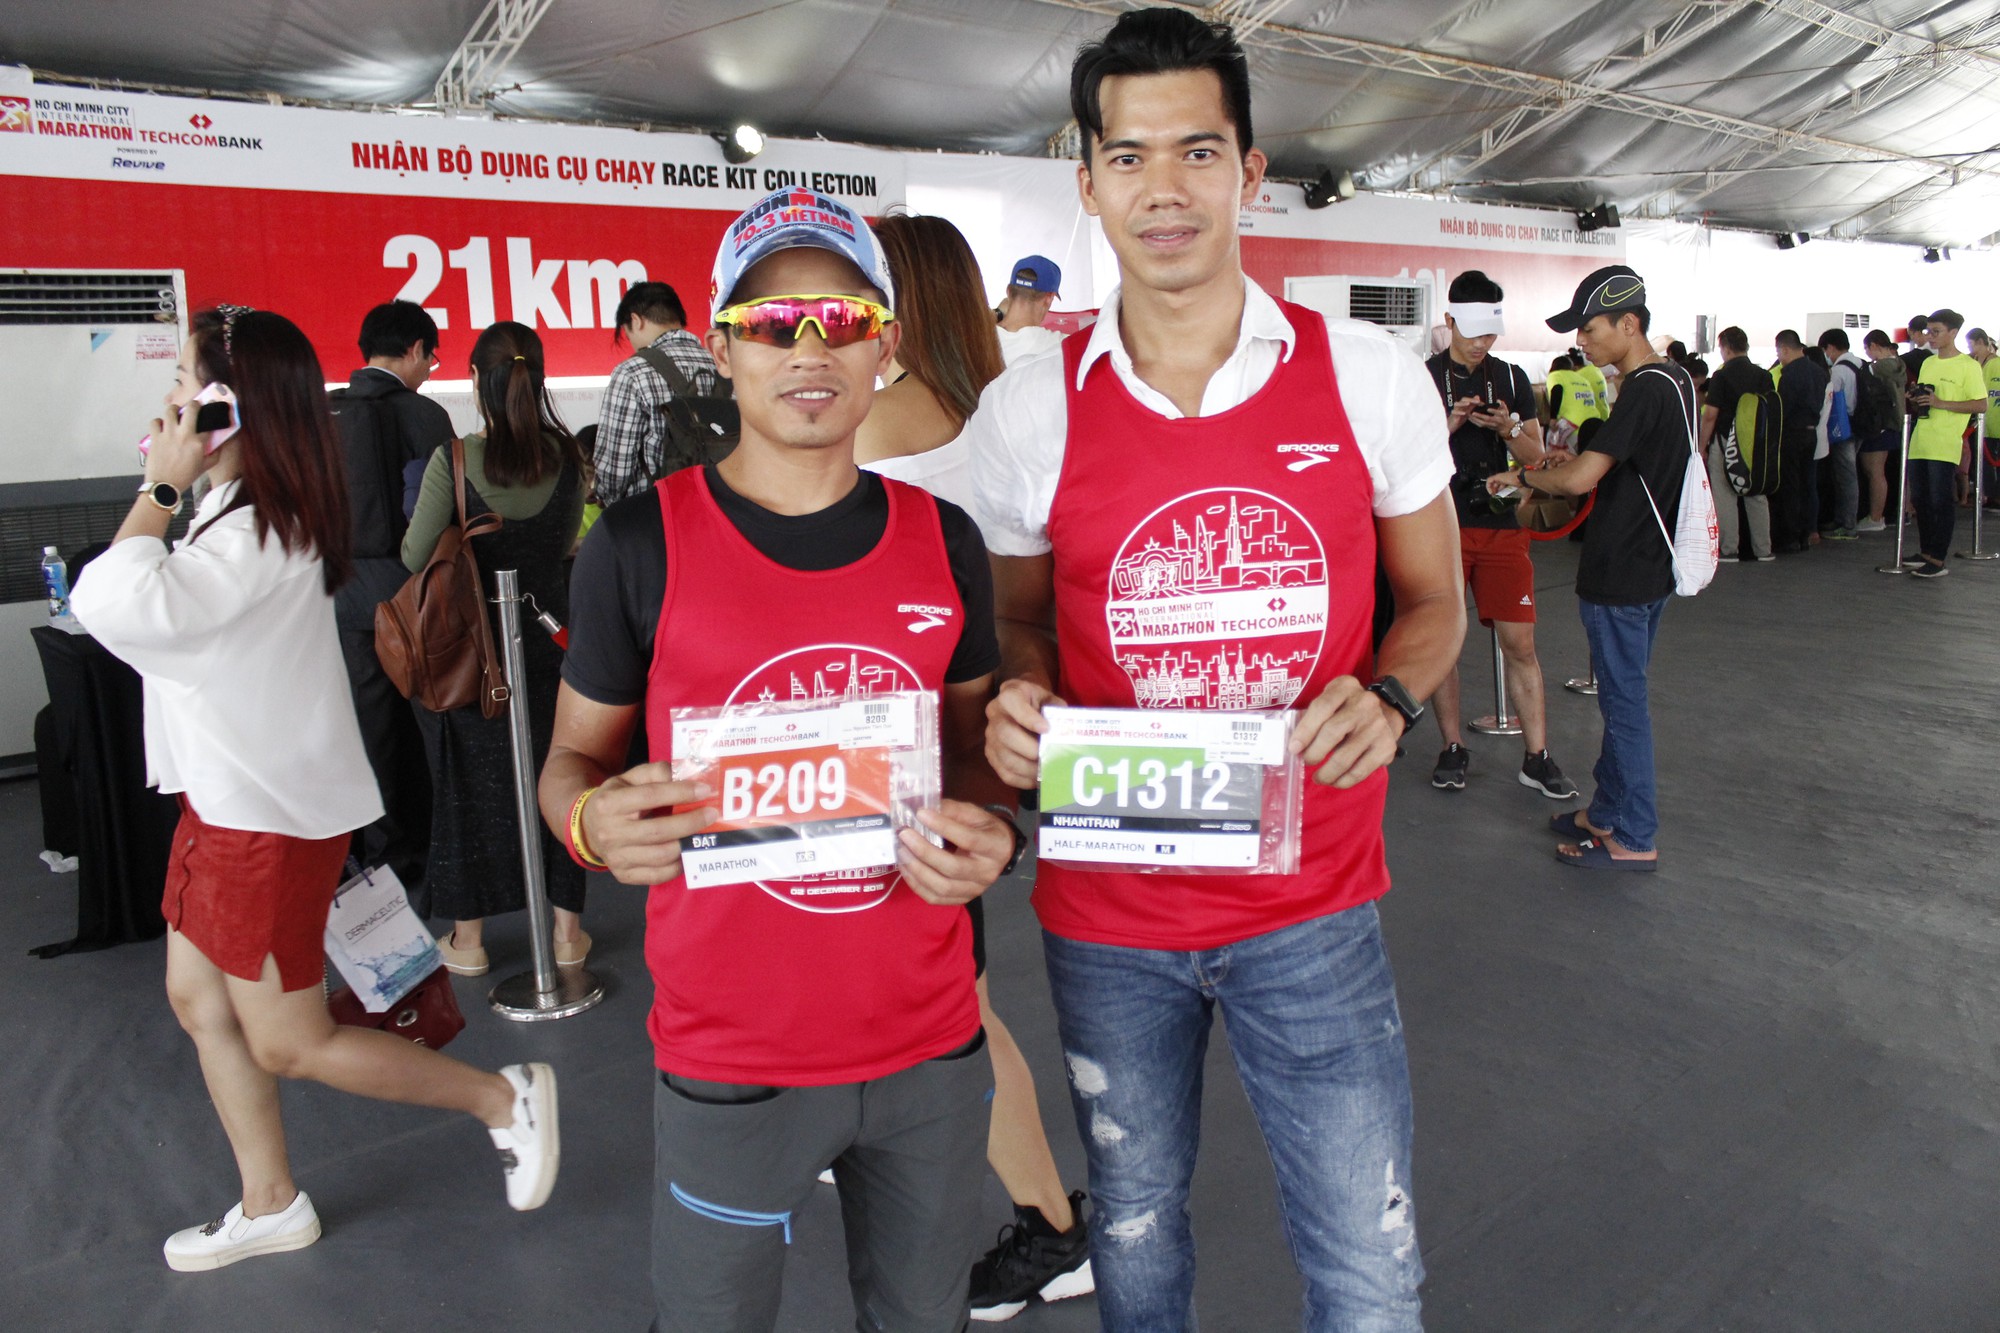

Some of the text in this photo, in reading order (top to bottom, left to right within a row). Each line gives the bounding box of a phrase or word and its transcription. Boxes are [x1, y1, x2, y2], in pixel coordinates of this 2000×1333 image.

[35, 99, 129, 116] HO CHI MINH CITY
[36, 111, 130, 126] INTERNATIONAL
[38, 120, 134, 141] MARATHON
[139, 129, 263, 151] TECHCOMBANK
[351, 140, 429, 177] NHẬN
[437, 144, 473, 180] BỘ
[480, 150, 549, 183] DỤNG
[557, 155, 588, 185] CỤ
[595, 158, 655, 190] CHẠY
[662, 162, 719, 188] RACE
[725, 166, 757, 190] KIT
[732, 188, 853, 239] IRONMAN
[733, 207, 856, 251] 70.3 VIETNAM
[1440, 216, 1616, 246] NHẬN BỘ DỤNG CỤ CHẠY RACE KIT COLLECTION
[1277, 443, 1340, 453] BROOKS
[897, 604, 953, 617] BROOKS
[1138, 601, 1214, 616] HO CHI MINH CITY
[1142, 620, 1215, 637] MARATHON
[1220, 612, 1324, 632] TECHCOMBANK
[759, 731, 820, 745] TECHCOMBANK
[1076, 729, 1121, 738] MARATHON
[1124, 731, 1188, 740] TECHCOMBANK
[1233, 732, 1258, 741] C1312
[722, 756, 847, 822] B209
[1072, 756, 1231, 811] C1312
[1053, 816, 1120, 829] NHANTRAN
[692, 835, 718, 850] ĐẠT
[1054, 839, 1146, 853] HALF-MARATHON
[698, 857, 758, 874] MARATHON
[807, 885, 861, 896] DECEMBER
[344, 895, 406, 941] DERMACEUTIC
